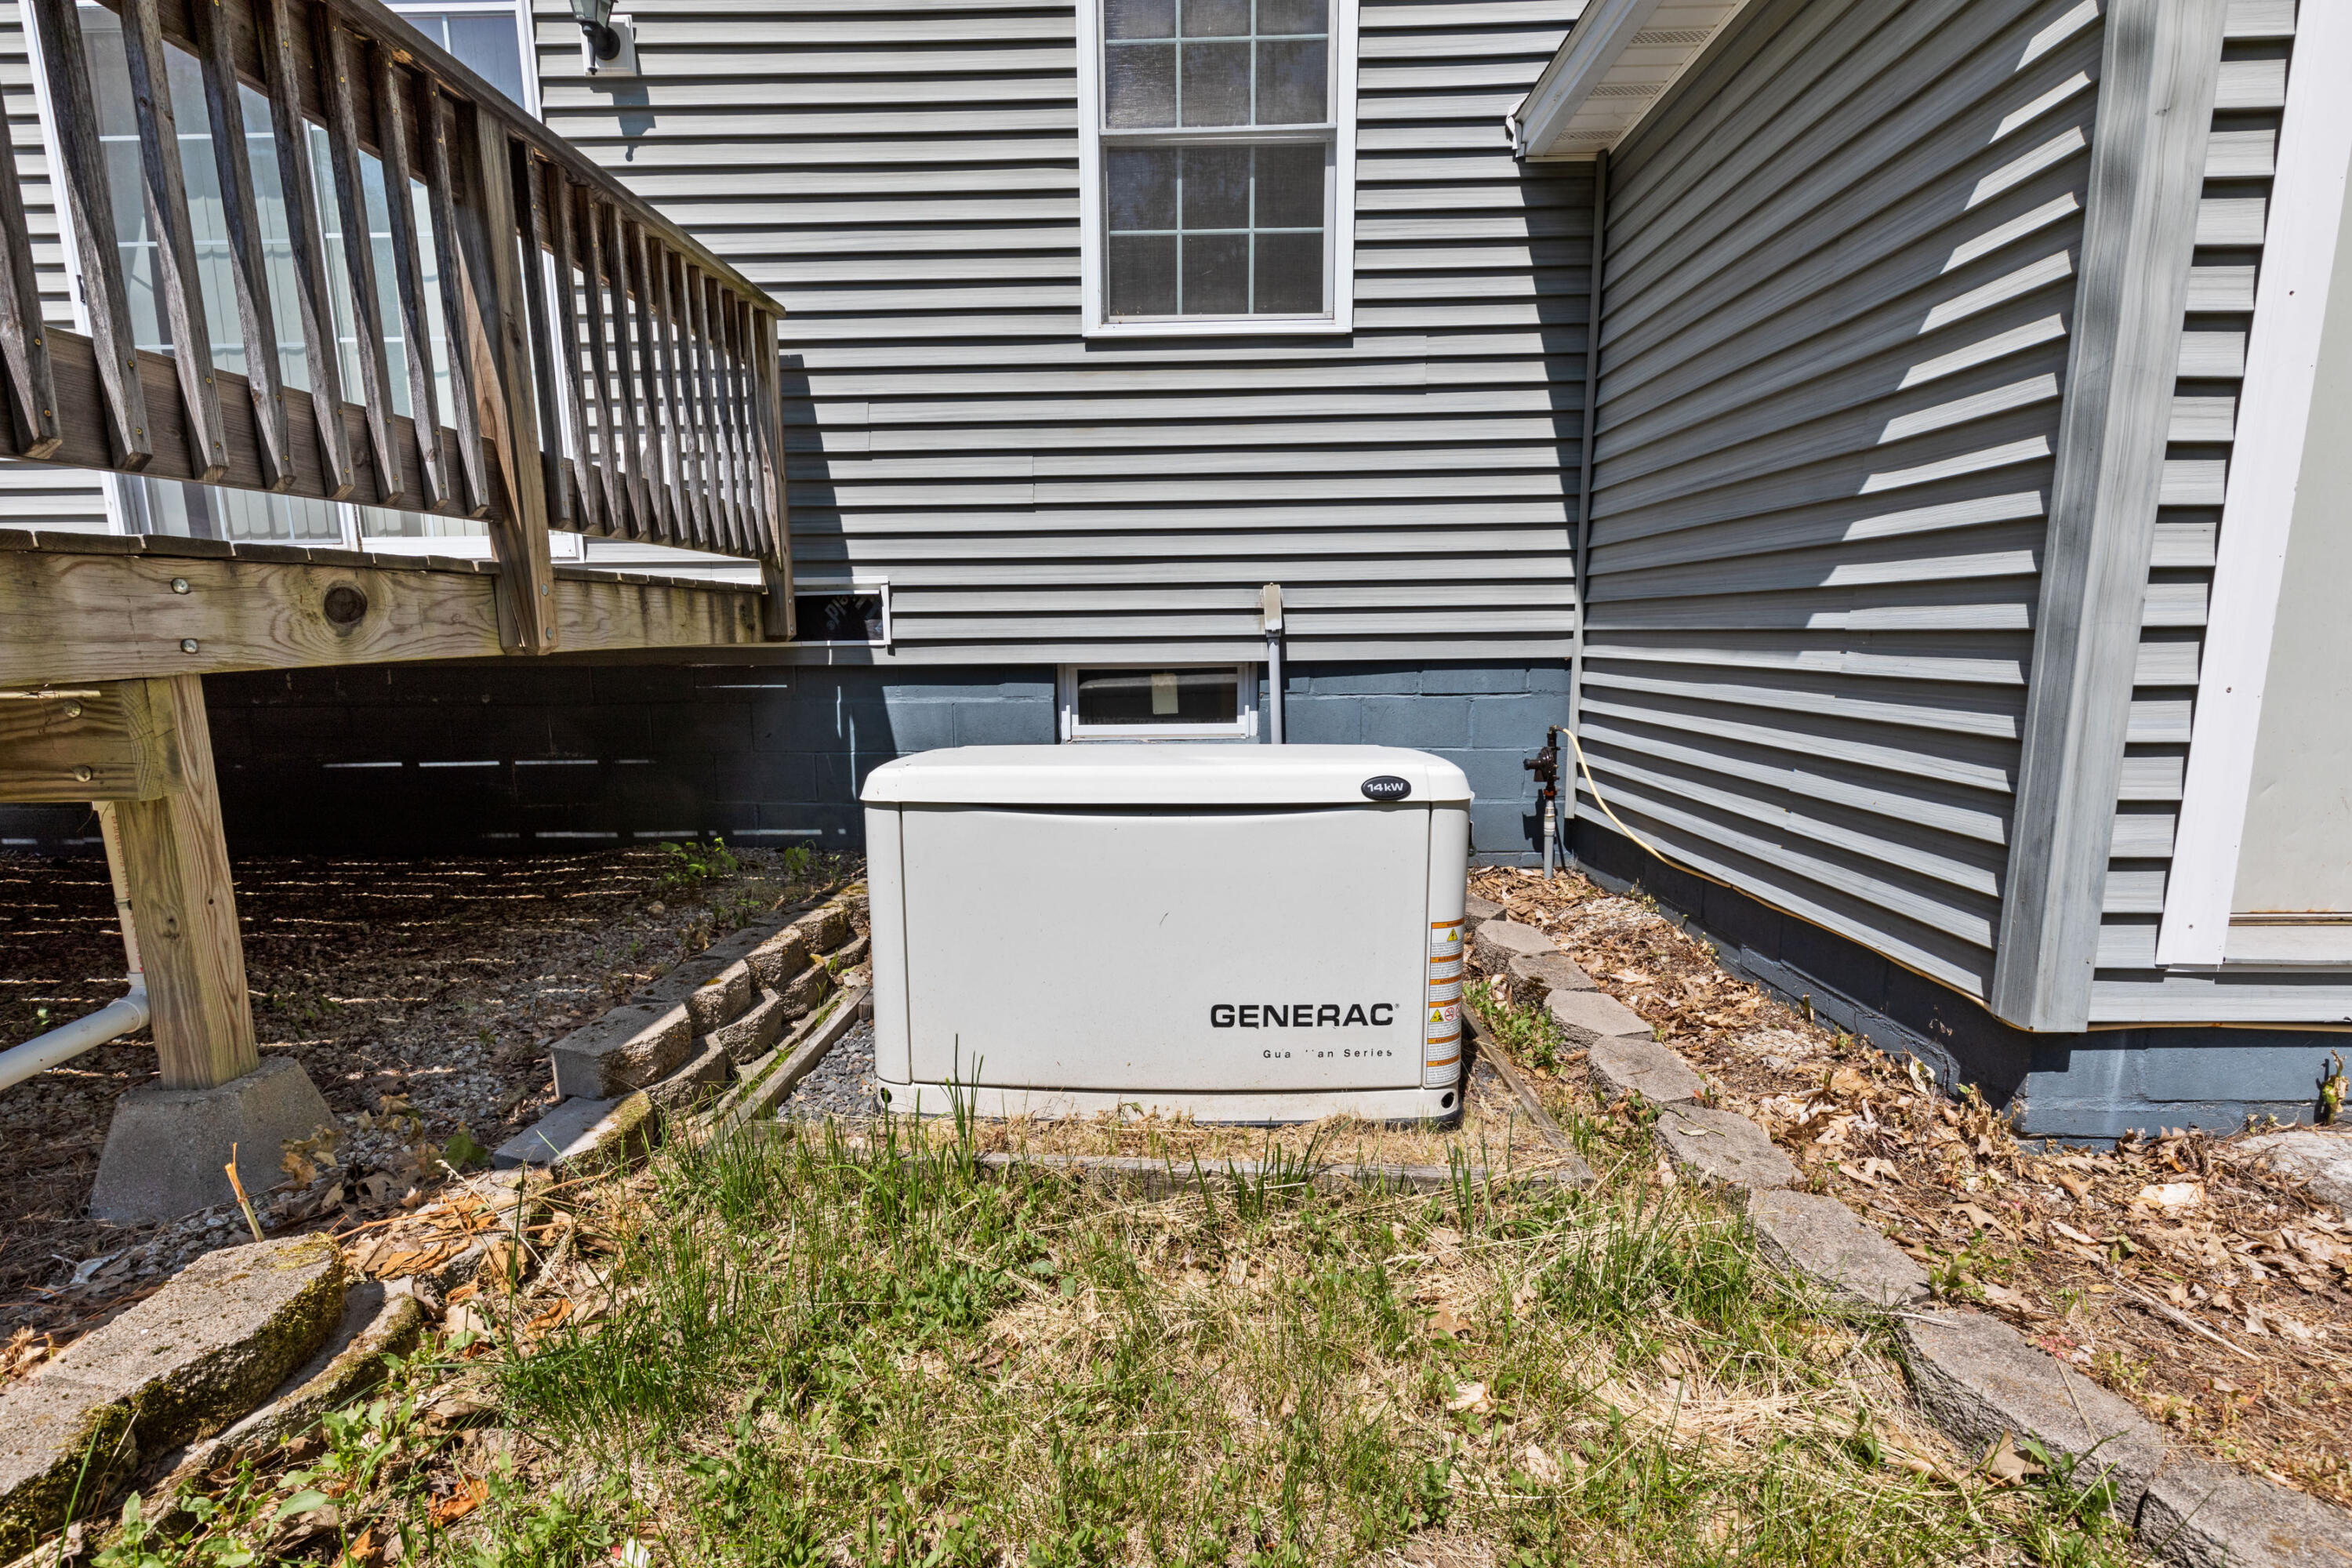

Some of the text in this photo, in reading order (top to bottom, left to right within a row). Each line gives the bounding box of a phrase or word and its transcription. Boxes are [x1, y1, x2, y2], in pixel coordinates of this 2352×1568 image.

[1367, 782, 1403, 792] 14kW
[1263, 1048, 1392, 1058] Guaan Series
